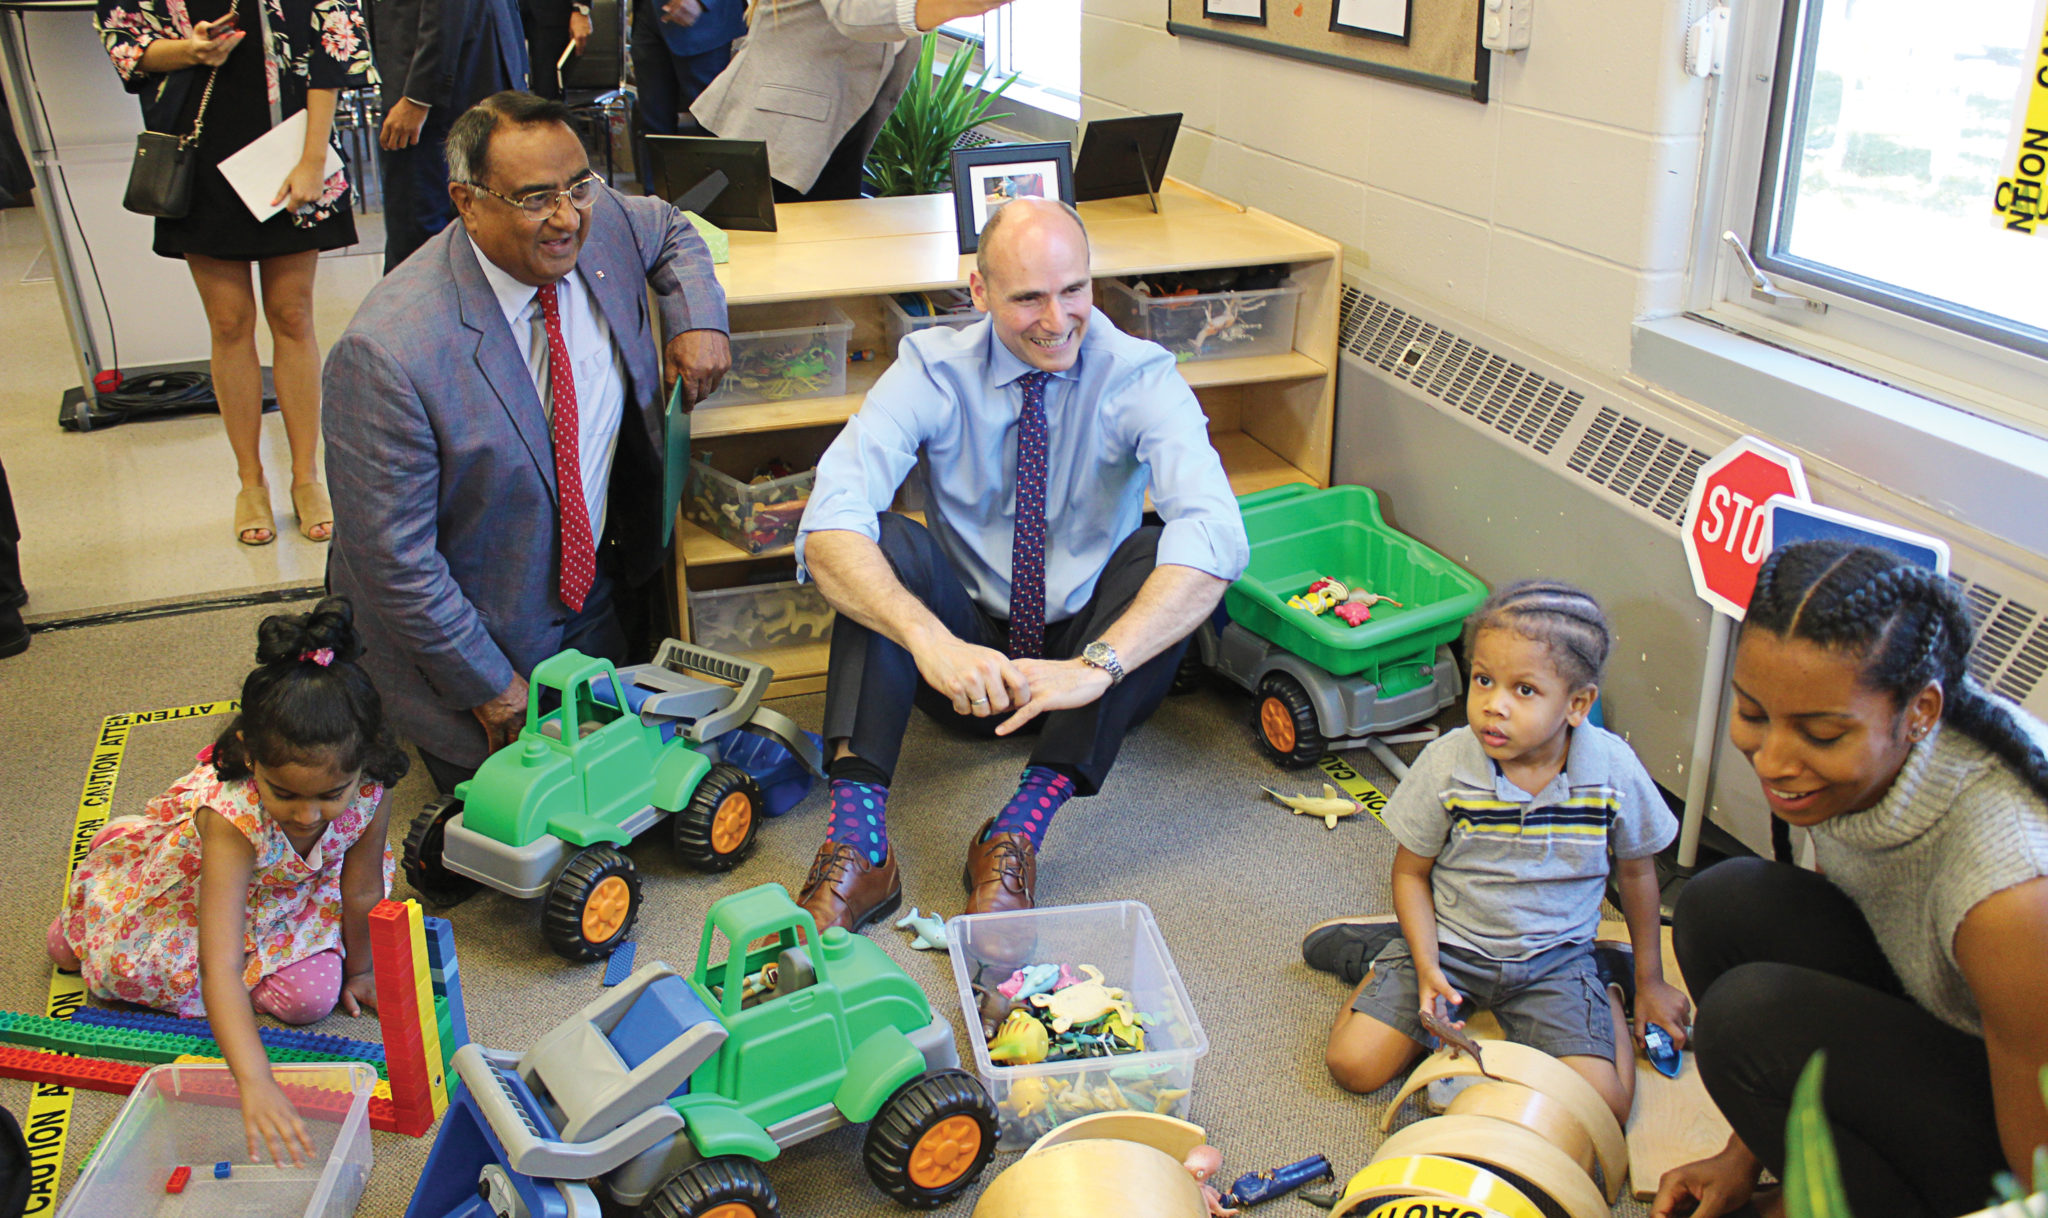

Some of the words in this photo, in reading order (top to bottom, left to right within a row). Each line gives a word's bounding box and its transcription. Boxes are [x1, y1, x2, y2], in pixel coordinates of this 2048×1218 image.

[1701, 485, 1765, 565] STO
[83, 752, 120, 807] CAUTION
[24, 1109, 67, 1216] CAUTION
